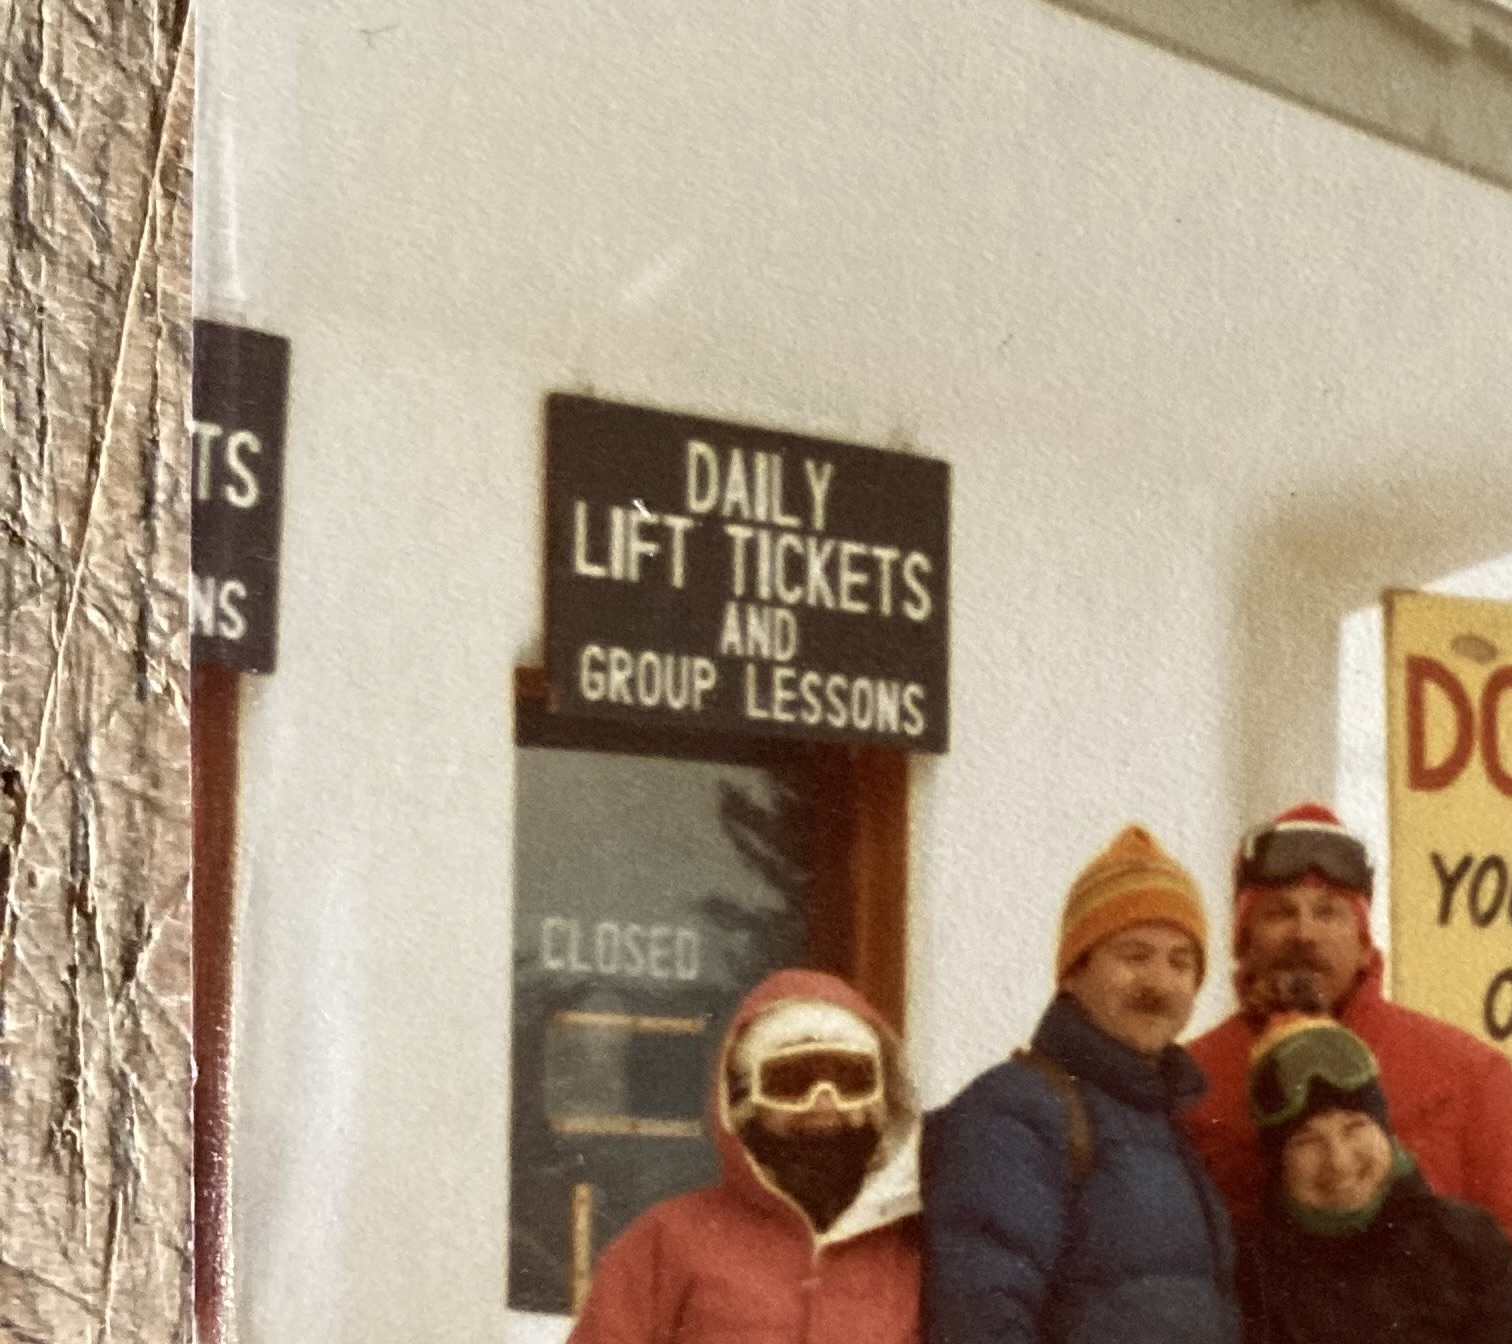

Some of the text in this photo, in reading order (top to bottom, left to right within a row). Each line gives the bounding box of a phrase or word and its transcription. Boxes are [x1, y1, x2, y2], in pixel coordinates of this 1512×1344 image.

[686, 440, 834, 530] DAILY
[573, 501, 933, 622] LIFT TICKETS
[719, 602, 797, 662] AND
[580, 646, 925, 736] GROUP LESSONS
[540, 917, 698, 980] CLOSED
